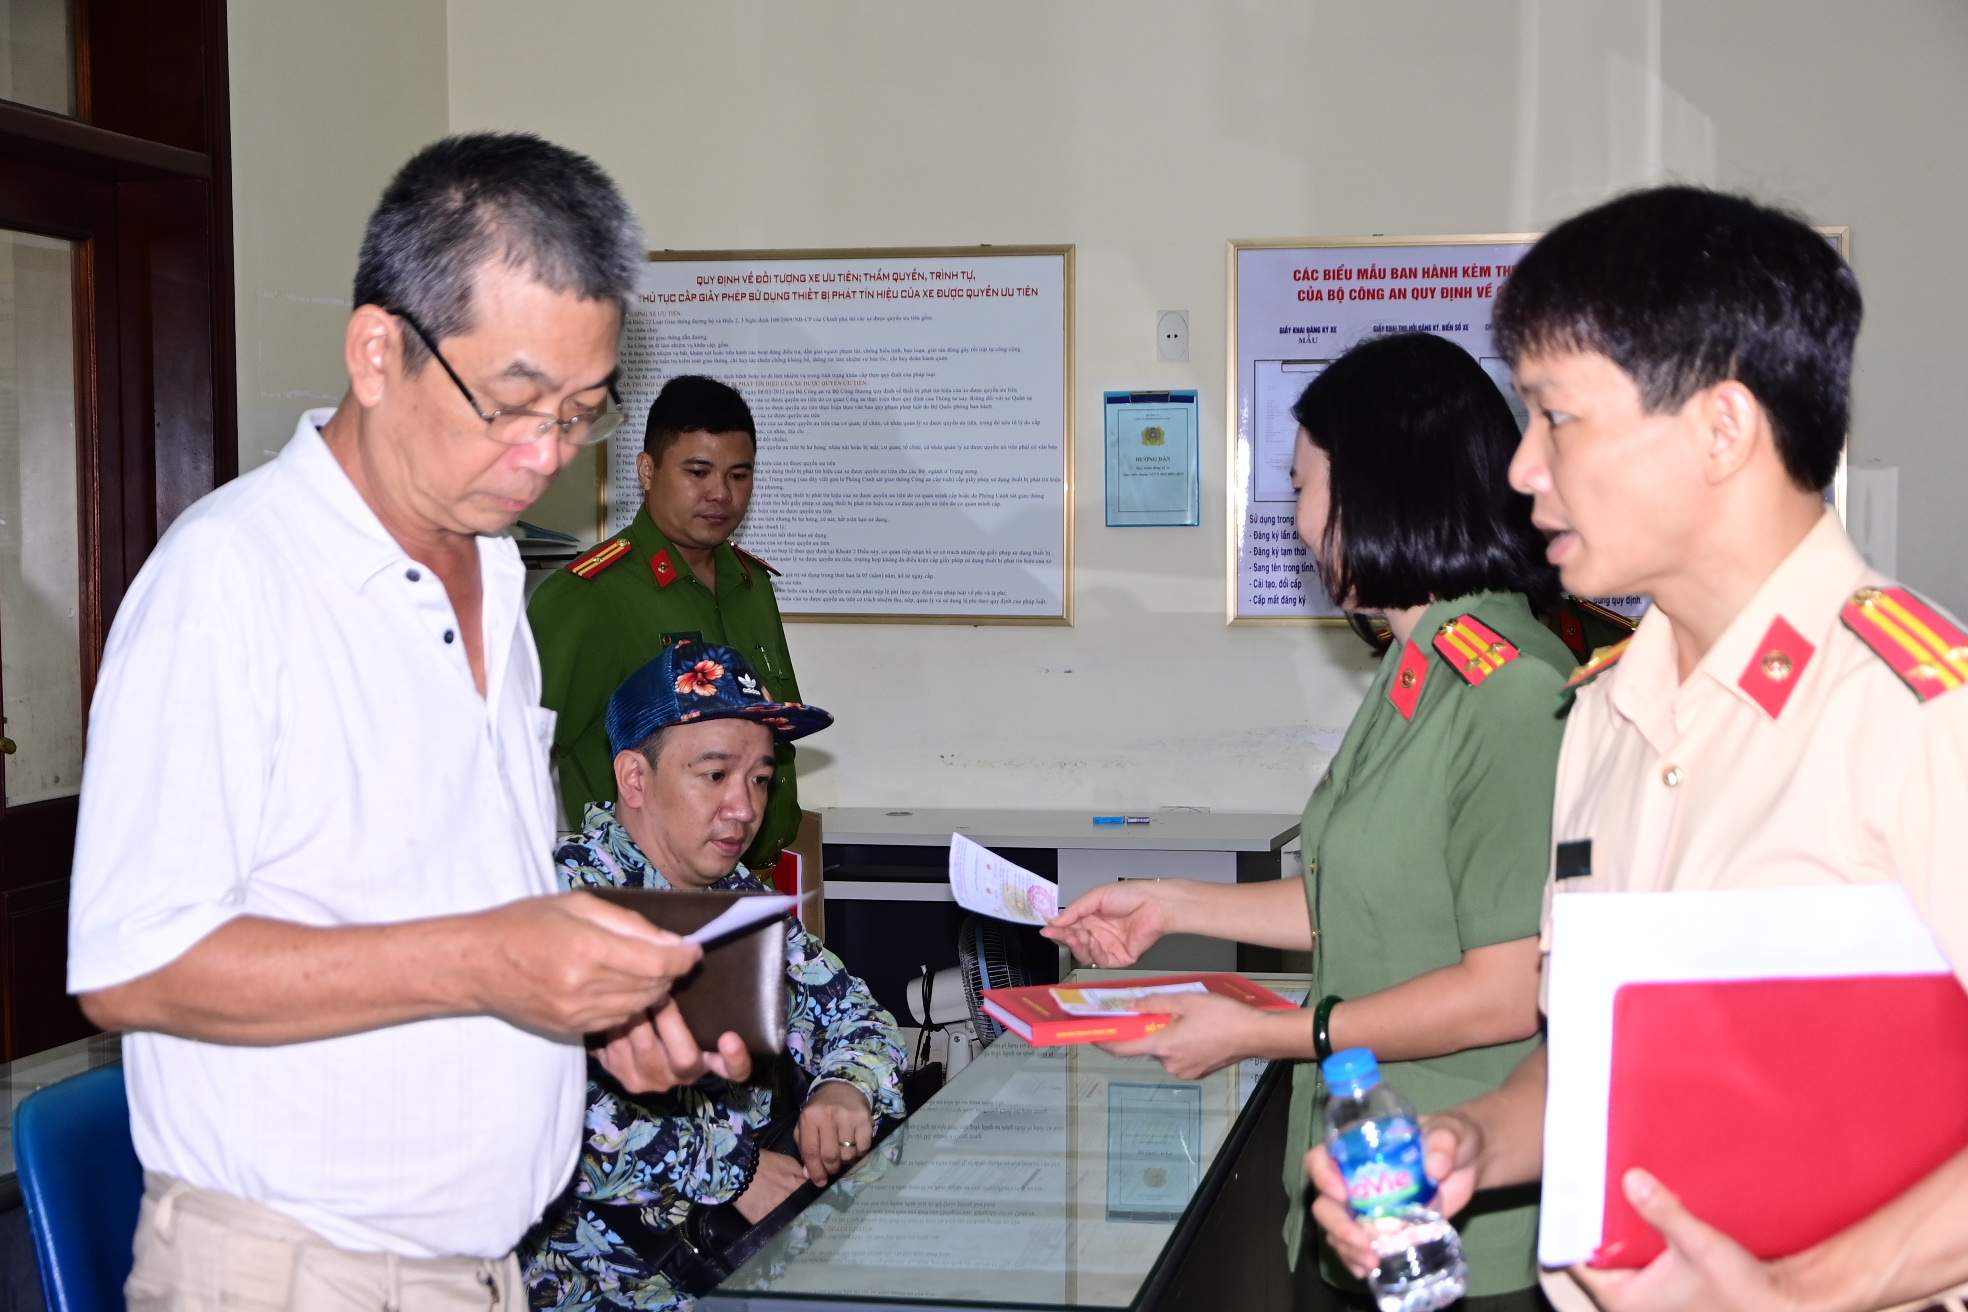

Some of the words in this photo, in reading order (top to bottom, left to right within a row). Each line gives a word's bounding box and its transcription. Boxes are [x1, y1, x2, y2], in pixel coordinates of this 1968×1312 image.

[697, 275, 715, 285] QUY
[716, 275, 740, 286] ĐỊNH
[742, 270, 754, 283] VỀ
[755, 270, 772, 282] ĐỐI
[773, 273, 806, 285] TƯỢNG
[808, 273, 820, 282] XE
[822, 272, 836, 282] ƯU
[837, 270, 862, 283] TIÊN;
[863, 268, 890, 281] THẨM
[892, 268, 928, 282] QUYỀN,
[929, 268, 958, 280] TRÌNH
[960, 270, 976, 282] TỰ,
[1293, 266, 1319, 281] CÁC
[1323, 264, 1352, 280] BIỂU
[1356, 263, 1386, 280] MẪU
[1390, 267, 1418, 279] BAN
[1422, 264, 1458, 278] HÀNH
[1462, 263, 1491, 278] KÈM
[657, 294, 676, 305] TỤC
[678, 289, 697, 302] CẤP
[698, 289, 720, 302] GIẤY
[721, 290, 746, 301] PHÉP
[748, 290, 762, 301] SỬ
[763, 292, 790, 303] DỤNG
[792, 287, 819, 300] THIẾT
[821, 291, 830, 302] BỊ
[831, 288, 857, 299] PHÁT
[858, 288, 874, 299] TÍN
[876, 287, 898, 302] HIỆU
[900, 287, 920, 298] CỦA
[922, 289, 934, 298] XE
[936, 288, 964, 300] ĐƯỢC
[966, 284, 998, 298] QUYỀN
[1000, 287, 1014, 296] ƯU
[1016, 285, 1038, 296] TIÊN
[1297, 286, 1324, 301] CỦA
[1327, 285, 1344, 304] BỘ
[1348, 285, 1384, 300] CÔNG
[1388, 288, 1407, 299] AN
[1411, 287, 1436, 300] QUY
[1440, 287, 1472, 302] ĐỊNH
[1476, 282, 1492, 298] VỀ
[1249, 514, 1258, 523] Sử
[1259, 515, 1276, 526] dụng
[1277, 515, 1295, 526] trong
[1253, 531, 1270, 542] Đăng
[1271, 531, 1279, 542] ký
[1280, 529, 1291, 540] lần
[1253, 547, 1270, 558] Đăng
[1271, 547, 1279, 558] ký
[1280, 548, 1292, 558] tạm
[1293, 547, 1307, 556] thời
[1253, 564, 1270, 574] Sang
[1271, 563, 1282, 572] tên
[1282, 564, 1300, 574] trong
[1301, 563, 1316, 573] tỉnh,
[1253, 580, 1264, 588] Cải
[1265, 580, 1277, 591] tạo,
[1278, 578, 1288, 588] đổi
[1290, 578, 1302, 591] cấp
[1253, 594, 1266, 607] Cấp
[1267, 594, 1280, 604] mất
[1280, 595, 1296, 607] đăng
[1298, 595, 1306, 607] ký
